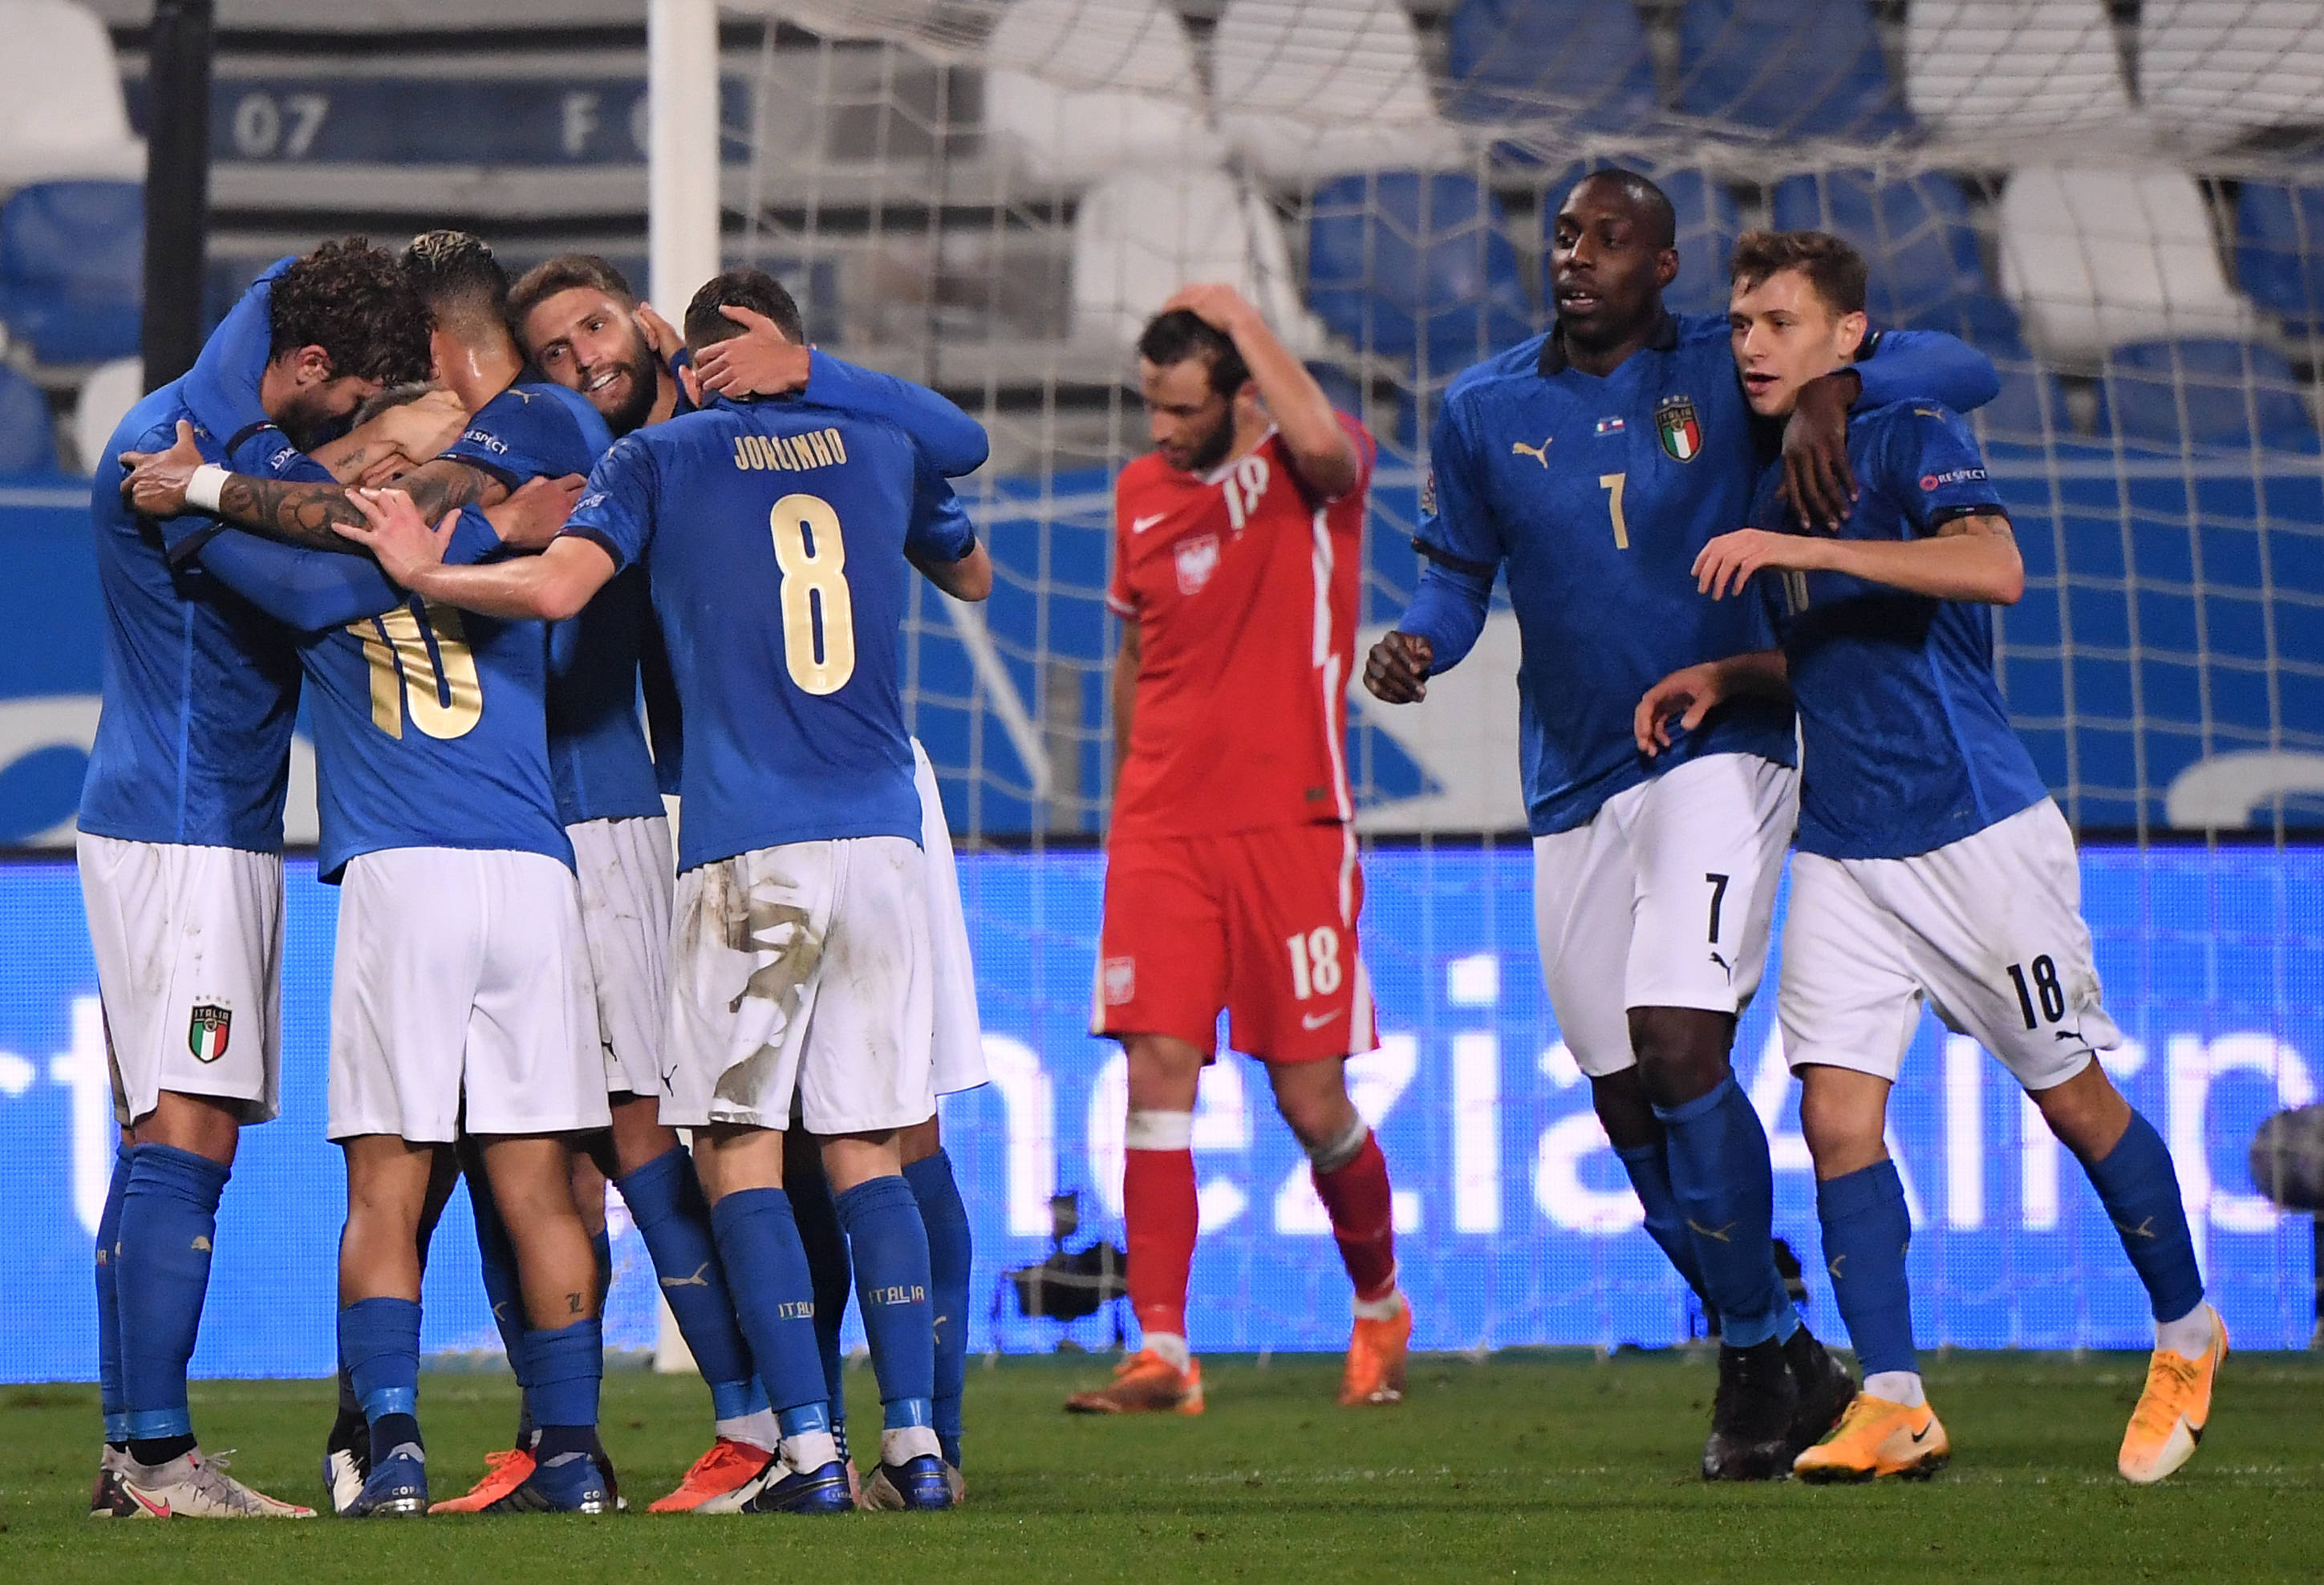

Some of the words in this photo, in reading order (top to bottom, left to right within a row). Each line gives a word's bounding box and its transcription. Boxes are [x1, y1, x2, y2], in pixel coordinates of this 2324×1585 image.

[233, 93, 330, 157] 07
[1600, 472, 1629, 549] 7
[769, 493, 855, 695] 8
[347, 602, 483, 740] 10
[1705, 873, 1730, 944] 7
[1286, 926, 1342, 1000] 18
[2006, 954, 2065, 1030] 18
[194, 1008, 229, 1021] ITALIA
[869, 1285, 925, 1304] ITALIA
